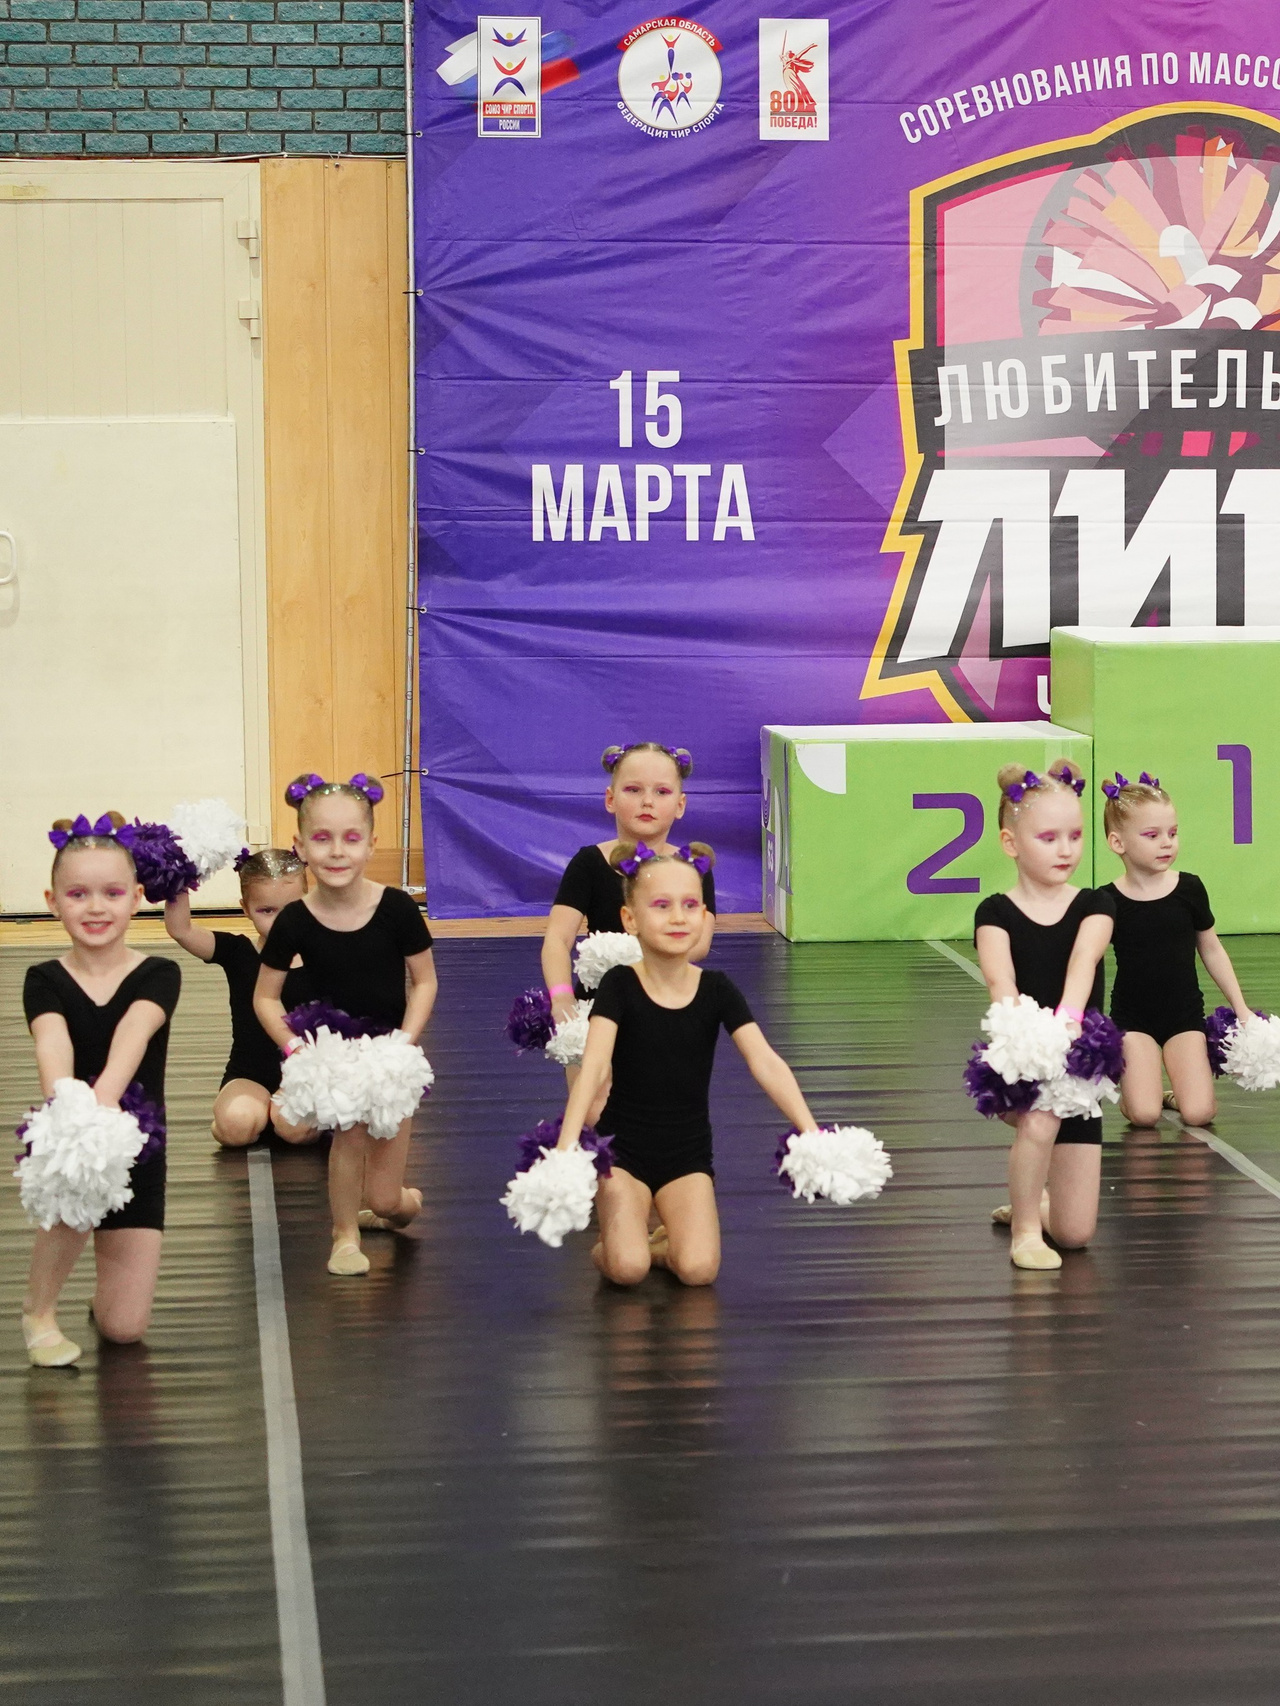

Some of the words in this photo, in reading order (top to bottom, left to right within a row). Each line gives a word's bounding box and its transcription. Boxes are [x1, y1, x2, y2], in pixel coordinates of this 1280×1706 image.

[623, 18, 677, 46] САМАРСКАЯ
[678, 20, 716, 47] ОБЛАСТЬ
[616, 101, 669, 139] ФЕДЕРАЦИЯ
[671, 128, 691, 139] ЧИР
[692, 102, 725, 133] СПОРТА
[770, 90, 796, 113] 80
[770, 116, 817, 130] ПОБЕДА!
[899, 54, 1132, 145] СОРЕВНОВАНИЯ
[1141, 51, 1180, 86] ПО
[609, 369, 683, 449] 15
[531, 463, 756, 542] МАРТА
[1217, 743, 1253, 845] 1
[906, 792, 985, 895] 2
